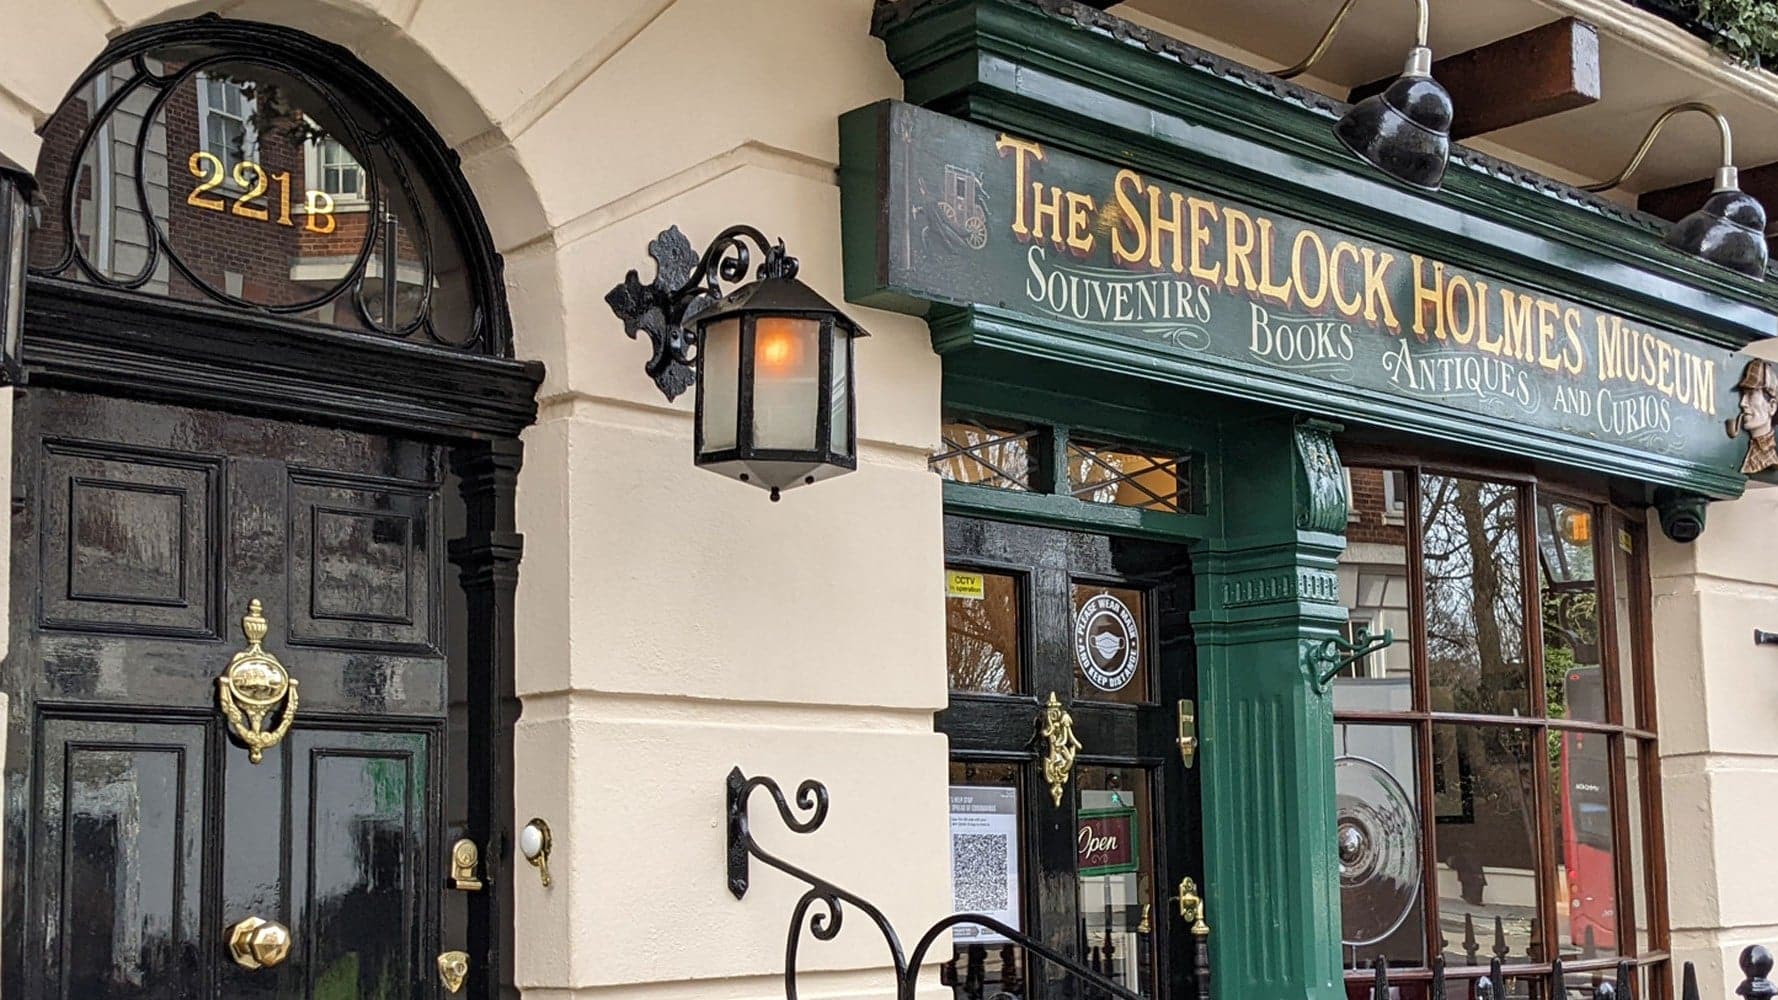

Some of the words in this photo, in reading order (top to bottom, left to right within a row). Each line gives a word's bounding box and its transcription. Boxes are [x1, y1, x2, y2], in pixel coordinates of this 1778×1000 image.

[995, 132, 1095, 253] THE
[1111, 168, 1401, 329] SHERLOCK
[1411, 253, 1586, 376] HOLMES
[1596, 314, 1717, 416] MUSEUM
[1026, 244, 1212, 324] SOUVENIRS
[1249, 301, 1354, 362] BOOKS
[1382, 338, 1531, 406] ANTIQUES
[1553, 384, 1592, 417] AND
[1596, 388, 1672, 436] CURIOS
[954, 575, 976, 584] CCTV
[1078, 602, 1096, 635] PLEASE
[1098, 599, 1120, 613] WEAR
[1120, 610, 1136, 639] MASK
[1078, 644, 1091, 669] AND
[1088, 667, 1108, 686] KEEP
[1109, 649, 1137, 687] DISTANCE
[1078, 825, 1118, 859] Open
